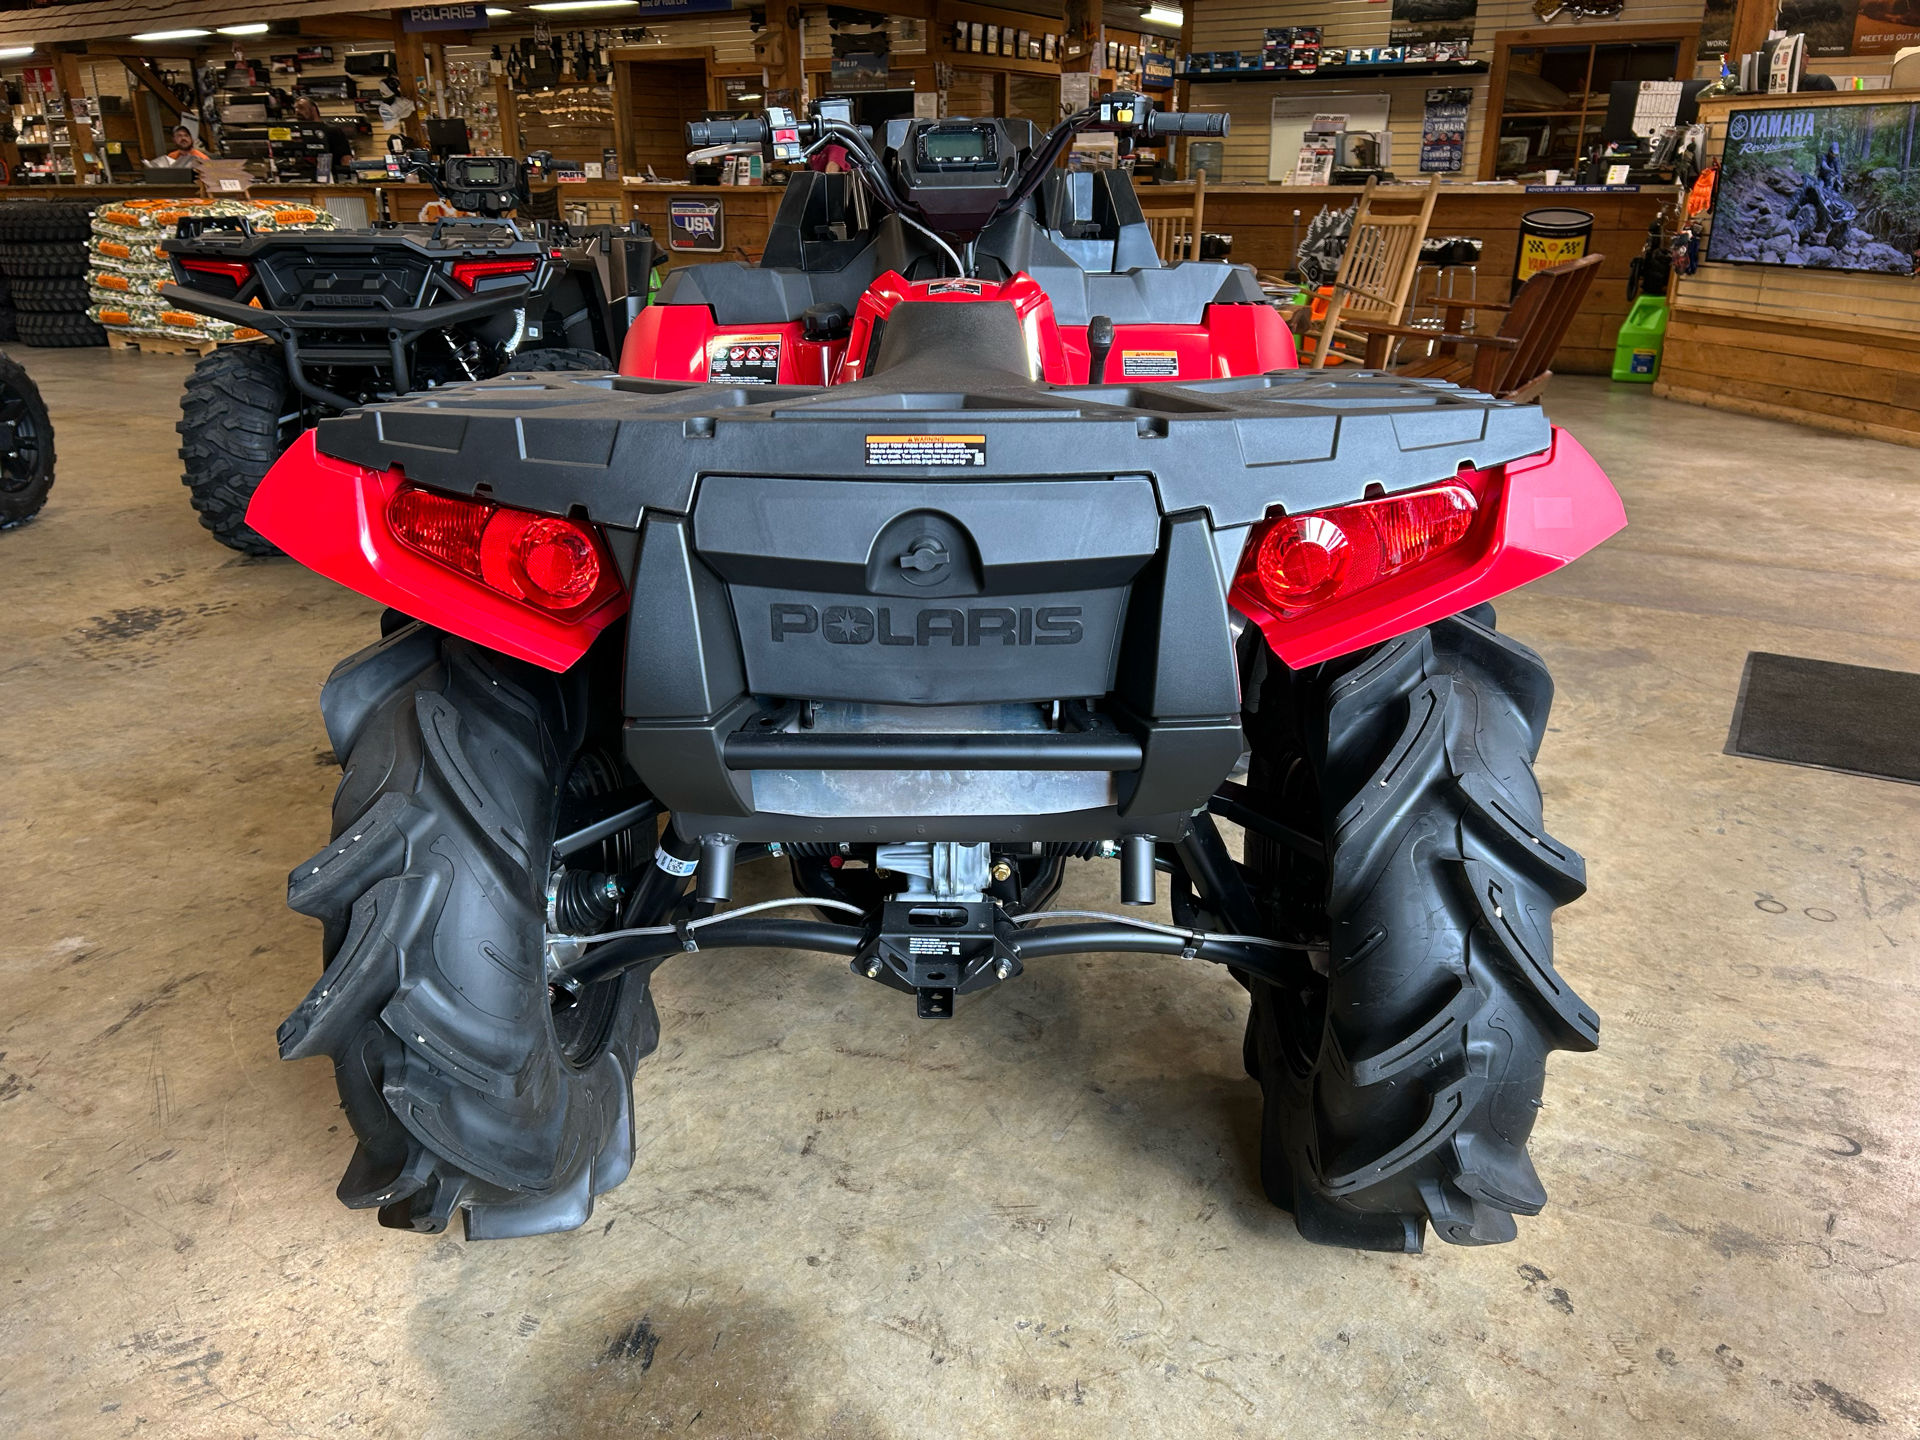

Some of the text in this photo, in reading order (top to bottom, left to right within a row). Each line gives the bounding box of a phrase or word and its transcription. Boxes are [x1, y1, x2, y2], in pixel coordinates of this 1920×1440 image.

[410, 5, 477, 23] POLARIS
[1706, 39, 1730, 47] WORK.
[1860, 34, 1881, 42] MEET
[1896, 33, 1913, 41] OUT
[1434, 122, 1465, 132] YAMAHA
[1750, 113, 1815, 138] YAMAHA
[684, 216, 715, 232] USA
[314, 295, 372, 305] POLARIS
[770, 603, 1084, 646] POLARIS
